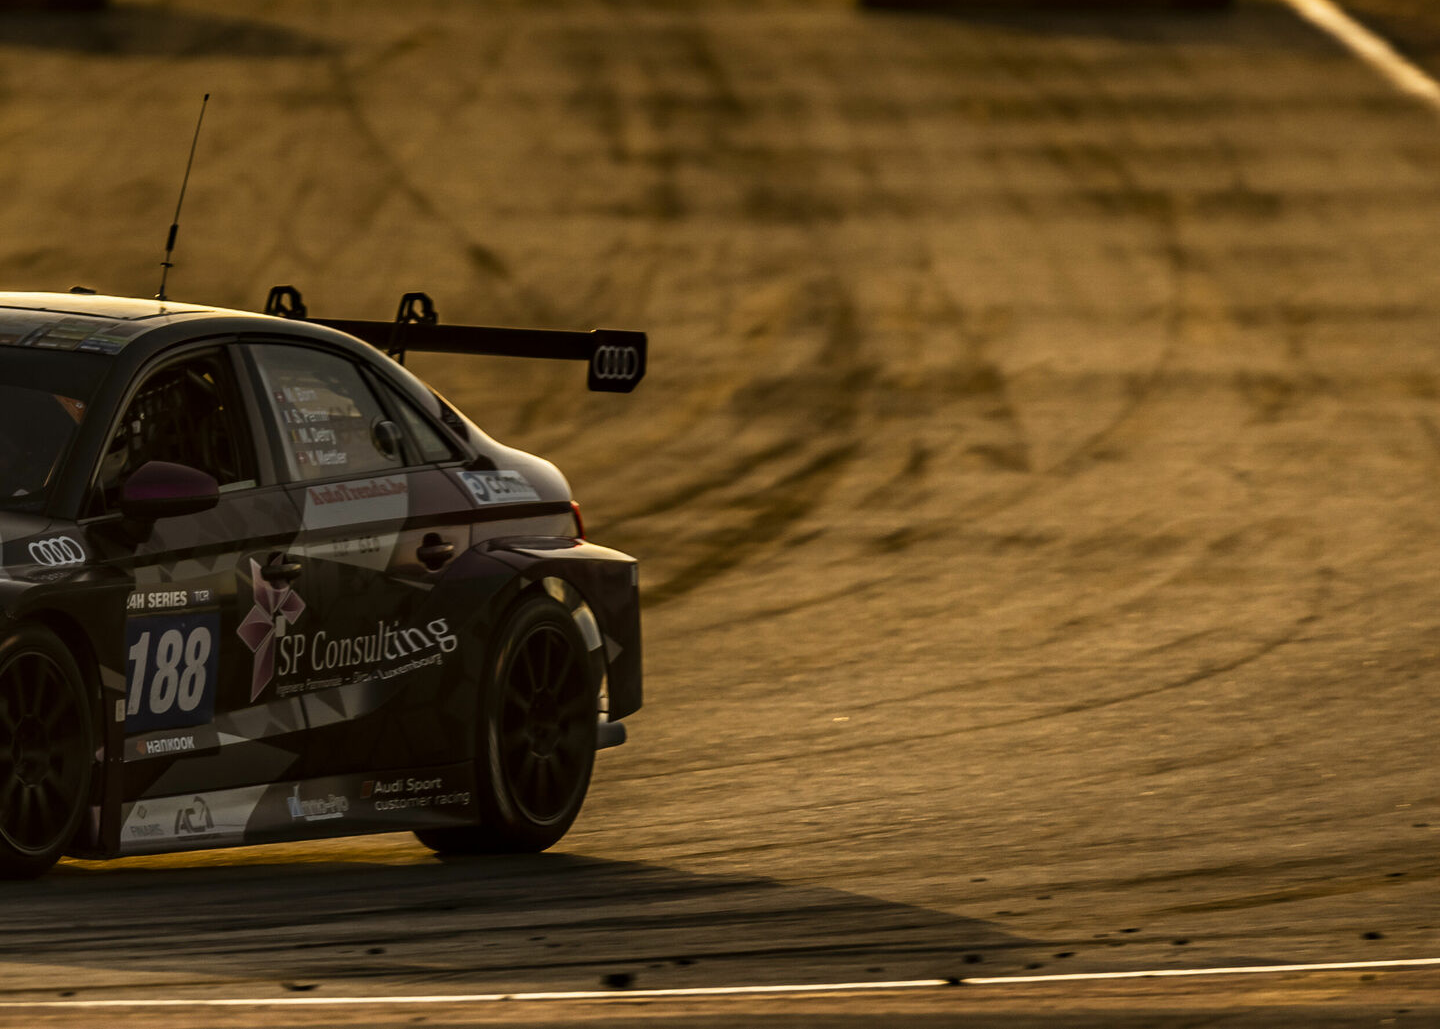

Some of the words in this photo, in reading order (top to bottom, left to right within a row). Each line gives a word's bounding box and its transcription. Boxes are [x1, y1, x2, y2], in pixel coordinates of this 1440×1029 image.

[148, 591, 188, 608] SERIES
[278, 634, 306, 676] SP
[311, 617, 457, 671] Consulting
[126, 626, 212, 715] 188
[374, 779, 403, 794] Audi
[405, 778, 443, 793] Sport
[375, 796, 432, 811] customer
[435, 792, 471, 805] racing
